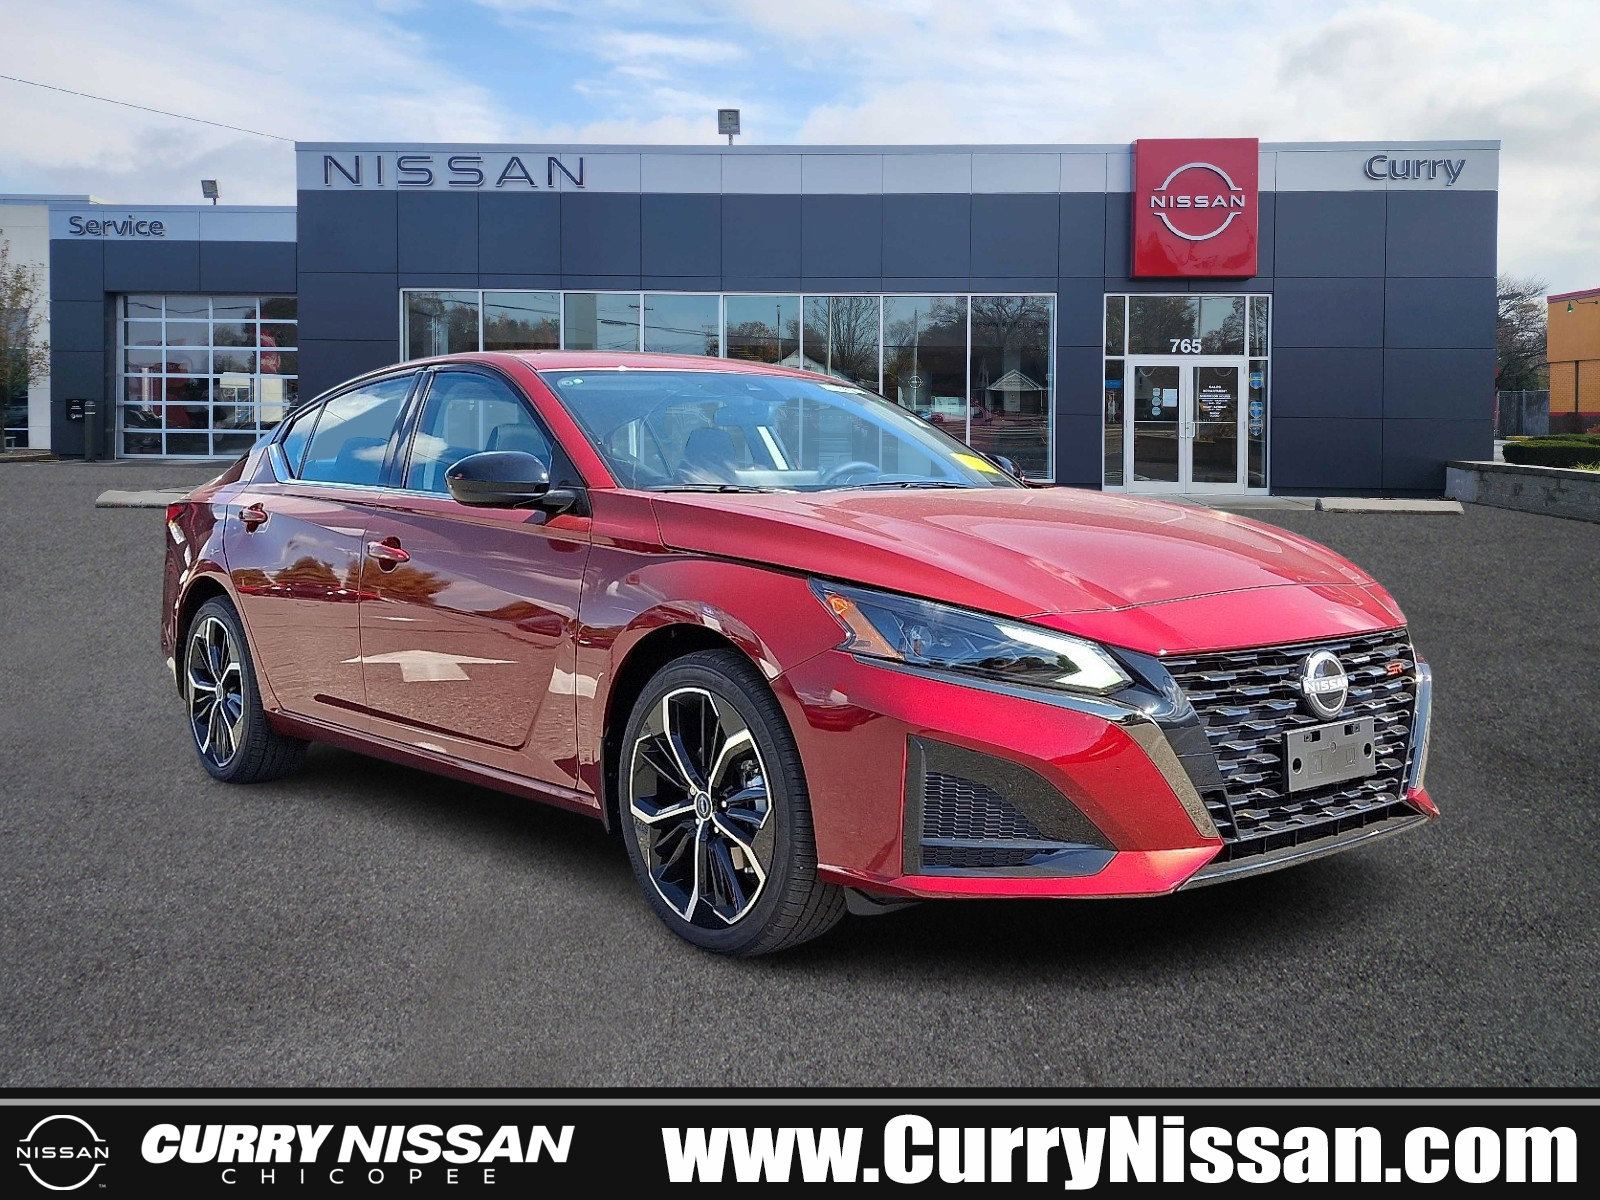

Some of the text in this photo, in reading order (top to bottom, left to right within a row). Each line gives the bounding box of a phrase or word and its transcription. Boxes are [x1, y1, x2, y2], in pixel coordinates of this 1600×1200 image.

[323, 155, 585, 188] NISSAN
[1364, 154, 1466, 187] Curry
[1150, 194, 1246, 208] NISSAN
[68, 214, 165, 237] Service
[1169, 338, 1202, 354] 765
[1385, 661, 1403, 676] SR
[1304, 675, 1347, 693] NISSA
